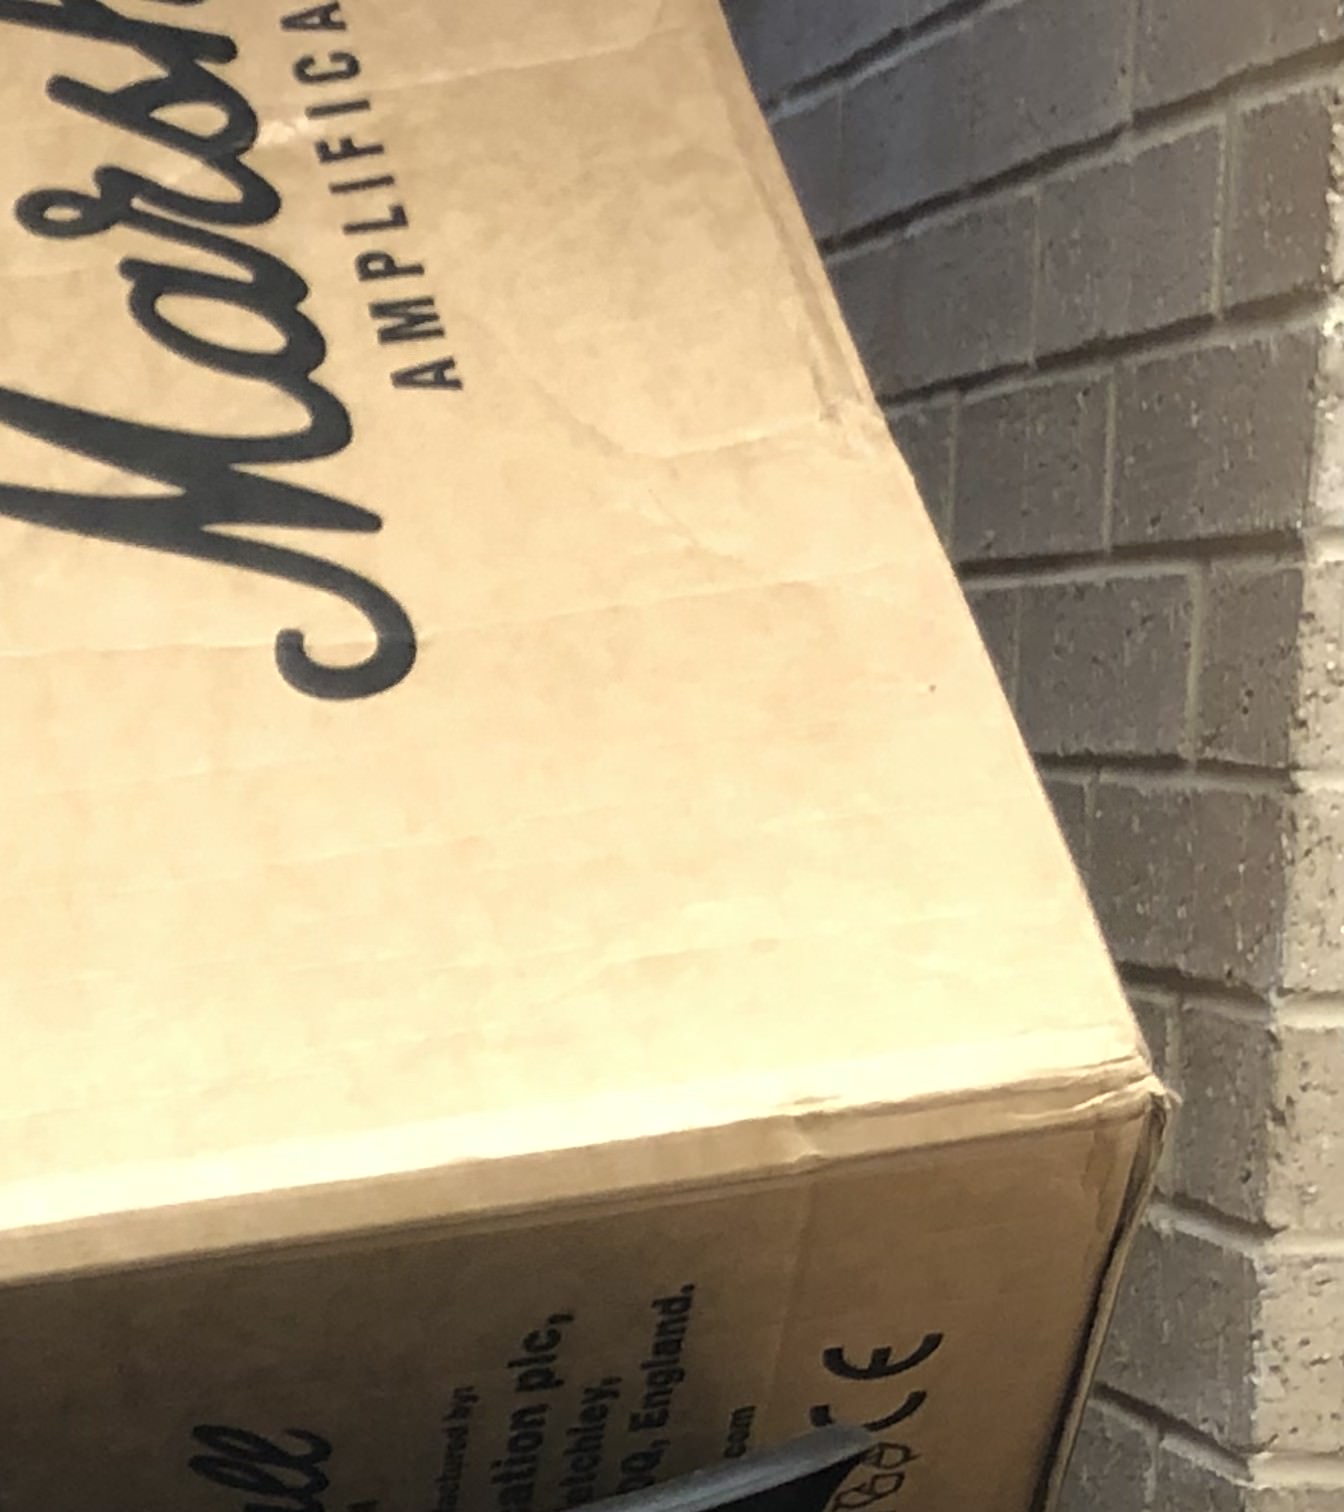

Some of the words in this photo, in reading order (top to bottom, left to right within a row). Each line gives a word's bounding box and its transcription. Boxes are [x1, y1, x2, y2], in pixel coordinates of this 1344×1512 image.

[281, 2, 463, 391] AMPLIFICA
[508, 1311, 574, 1399] plc,
[628, 1284, 696, 1430] England.
[559, 1376, 623, 1507] etchley,
